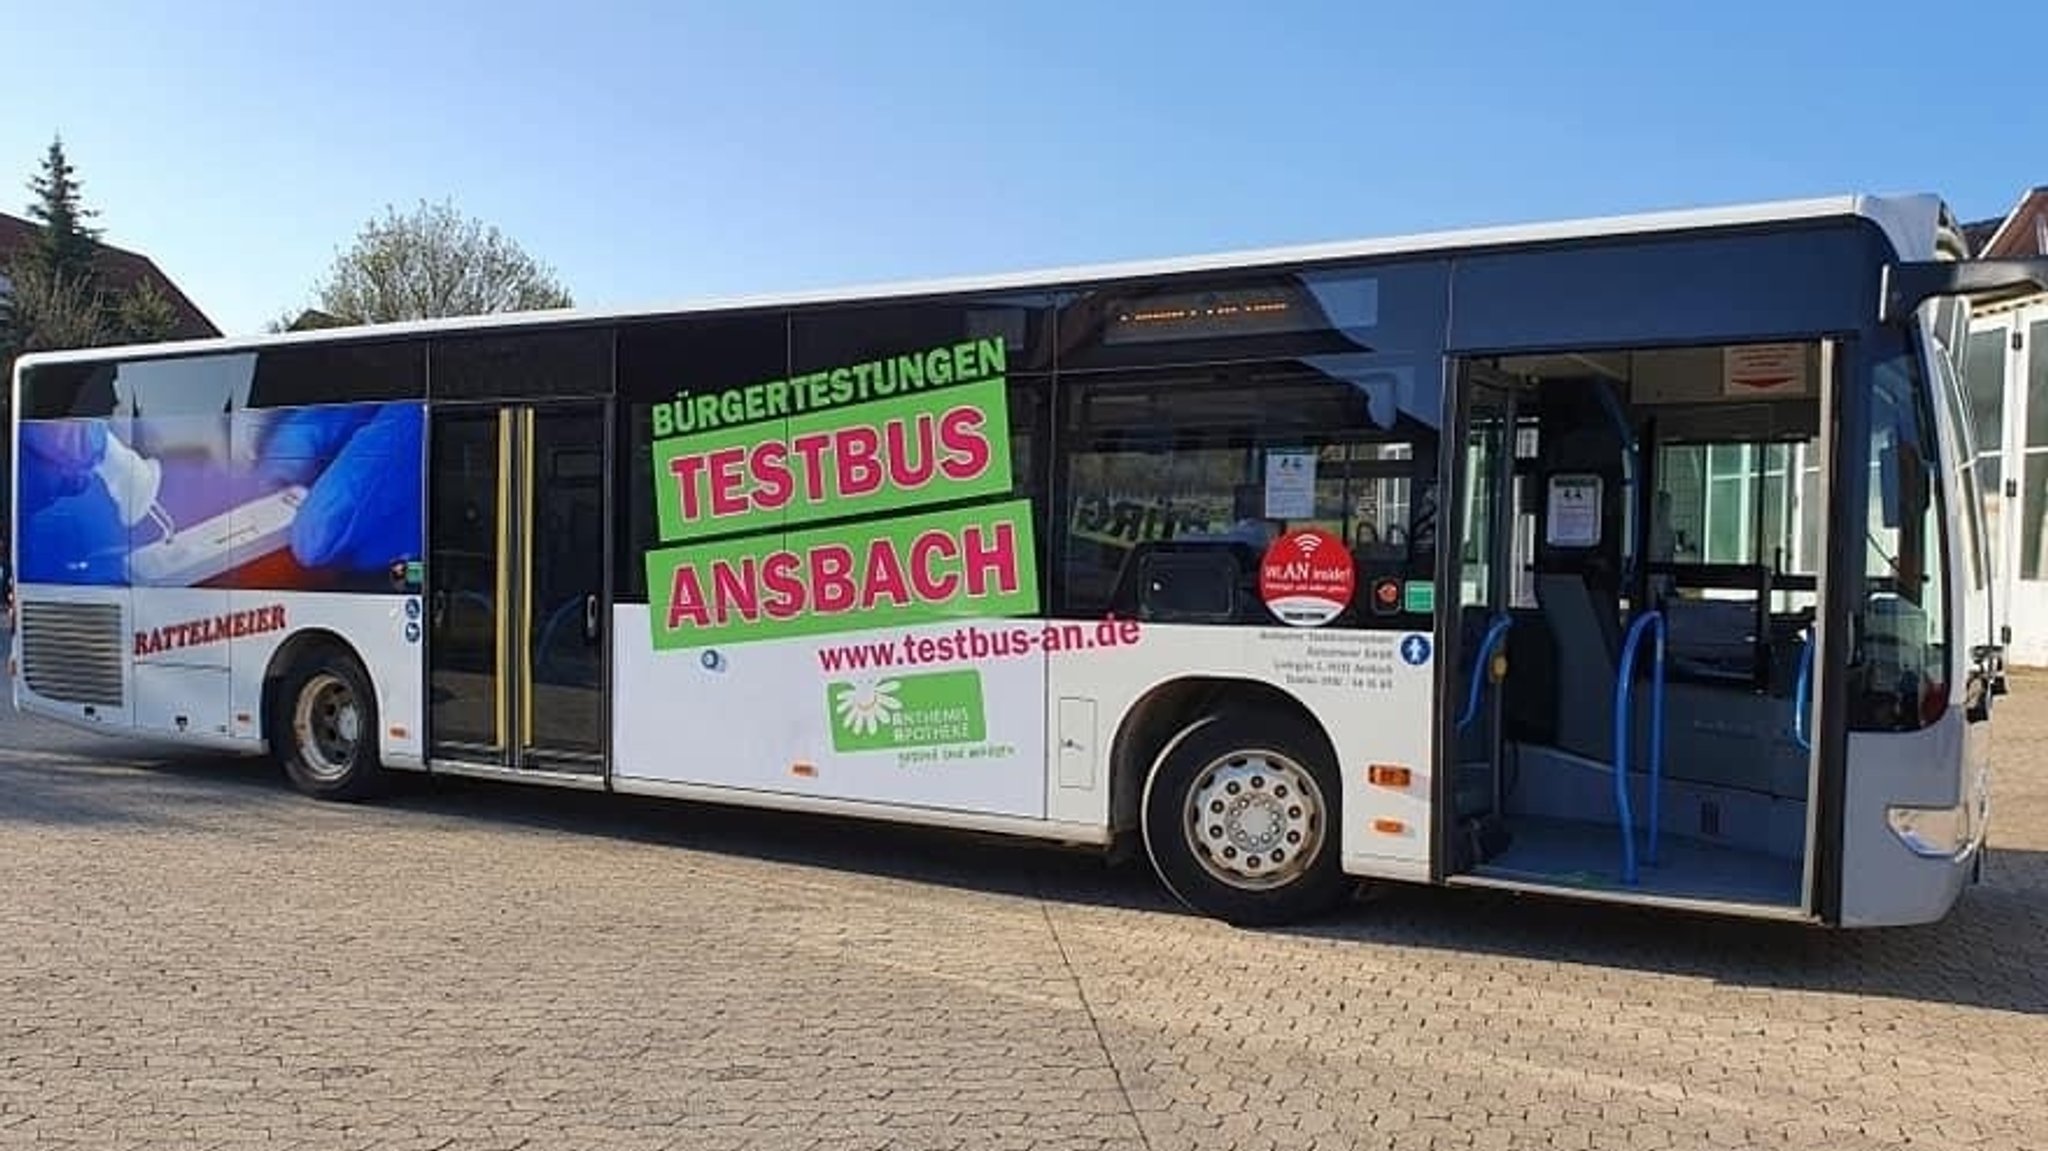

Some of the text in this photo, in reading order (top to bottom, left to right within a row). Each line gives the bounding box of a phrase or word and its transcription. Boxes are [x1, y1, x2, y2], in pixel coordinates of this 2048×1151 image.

[652, 337, 1006, 437] BÜRGERTESTUNGEN
[669, 405, 991, 522] TESTBUS
[666, 523, 1018, 631] ANSBACH
[1265, 562, 1311, 581] WLAN
[134, 603, 286, 656] RATTELMEIER
[819, 613, 1141, 672] www.testbus-an.de
